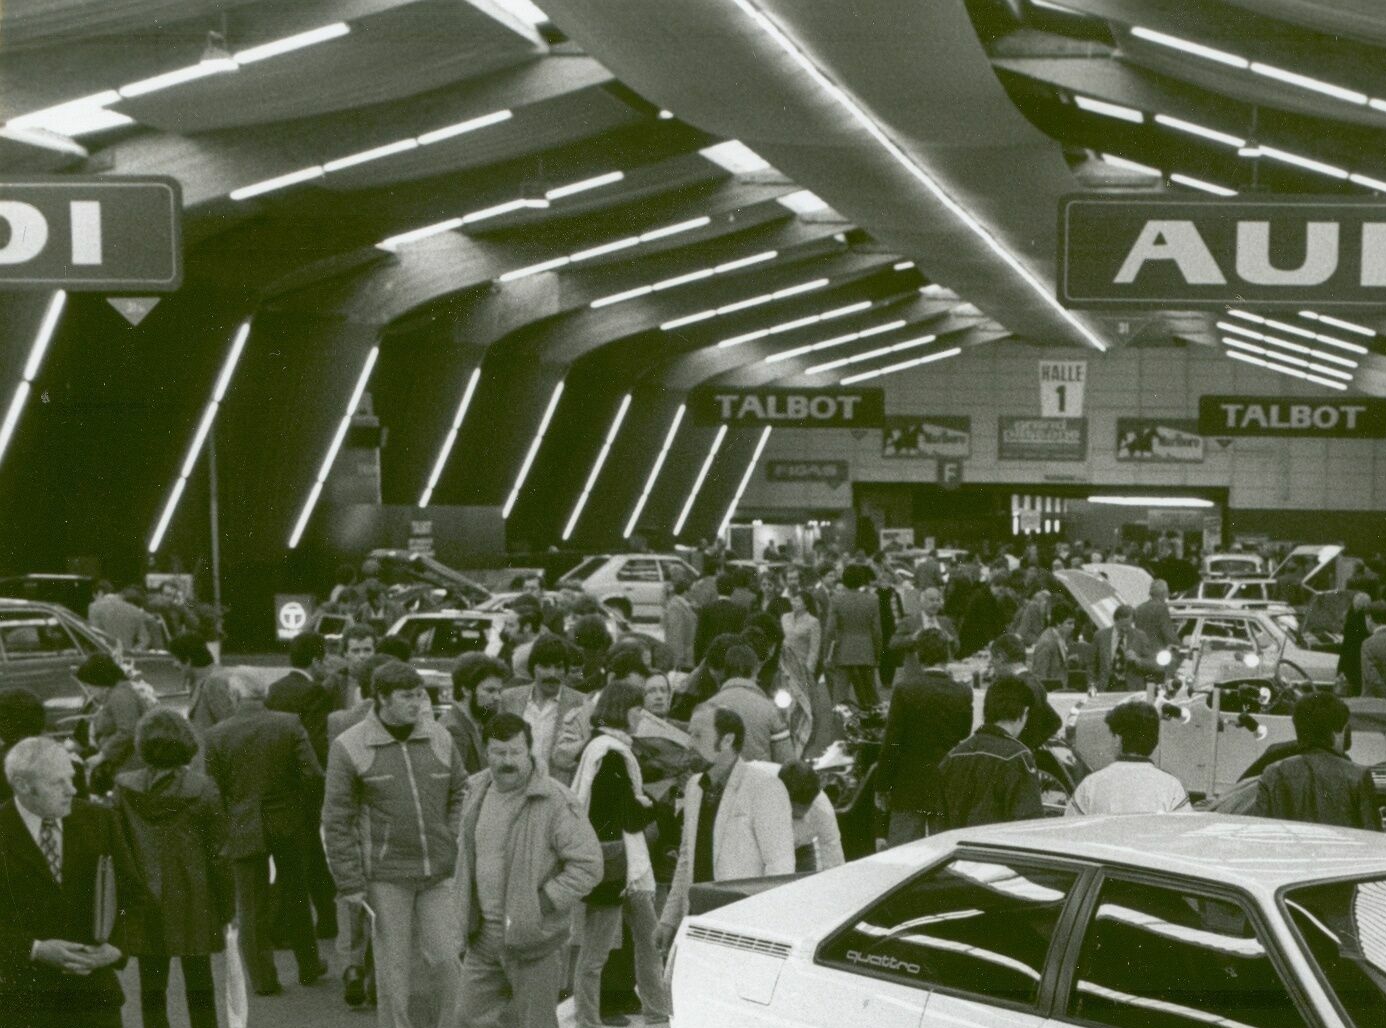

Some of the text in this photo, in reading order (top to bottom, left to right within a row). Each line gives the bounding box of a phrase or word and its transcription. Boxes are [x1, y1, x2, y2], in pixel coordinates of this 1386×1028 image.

[1041, 364, 1084, 382] HALLE
[715, 395, 861, 420] TALBOT
[1056, 385, 1066, 412] 1
[1220, 403, 1367, 430] TALBOT
[846, 949, 921, 974] quattro
